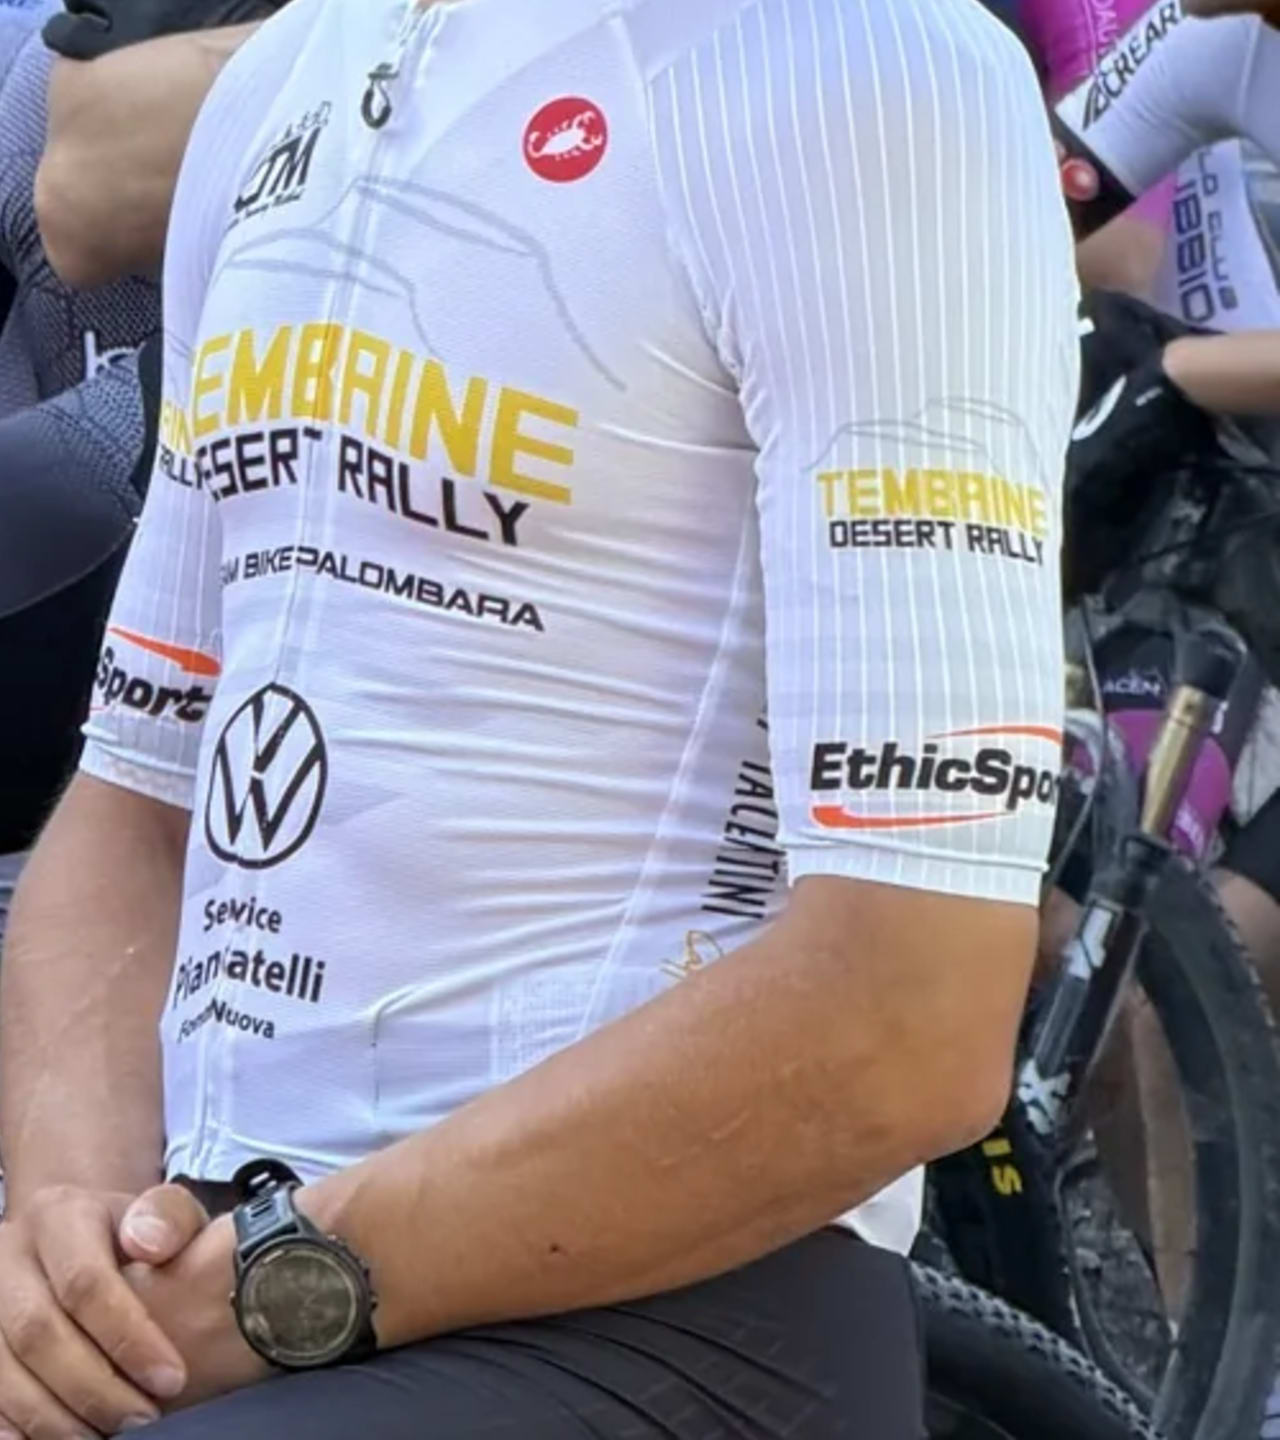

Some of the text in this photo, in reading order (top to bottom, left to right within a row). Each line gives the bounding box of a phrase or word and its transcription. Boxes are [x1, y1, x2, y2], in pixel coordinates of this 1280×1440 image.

[338, 439, 531, 547] RALLY
[828, 519, 1044, 567] DESERT RALLY
[243, 546, 294, 581] BIKE
[295, 547, 545, 632] PALOMBARA
